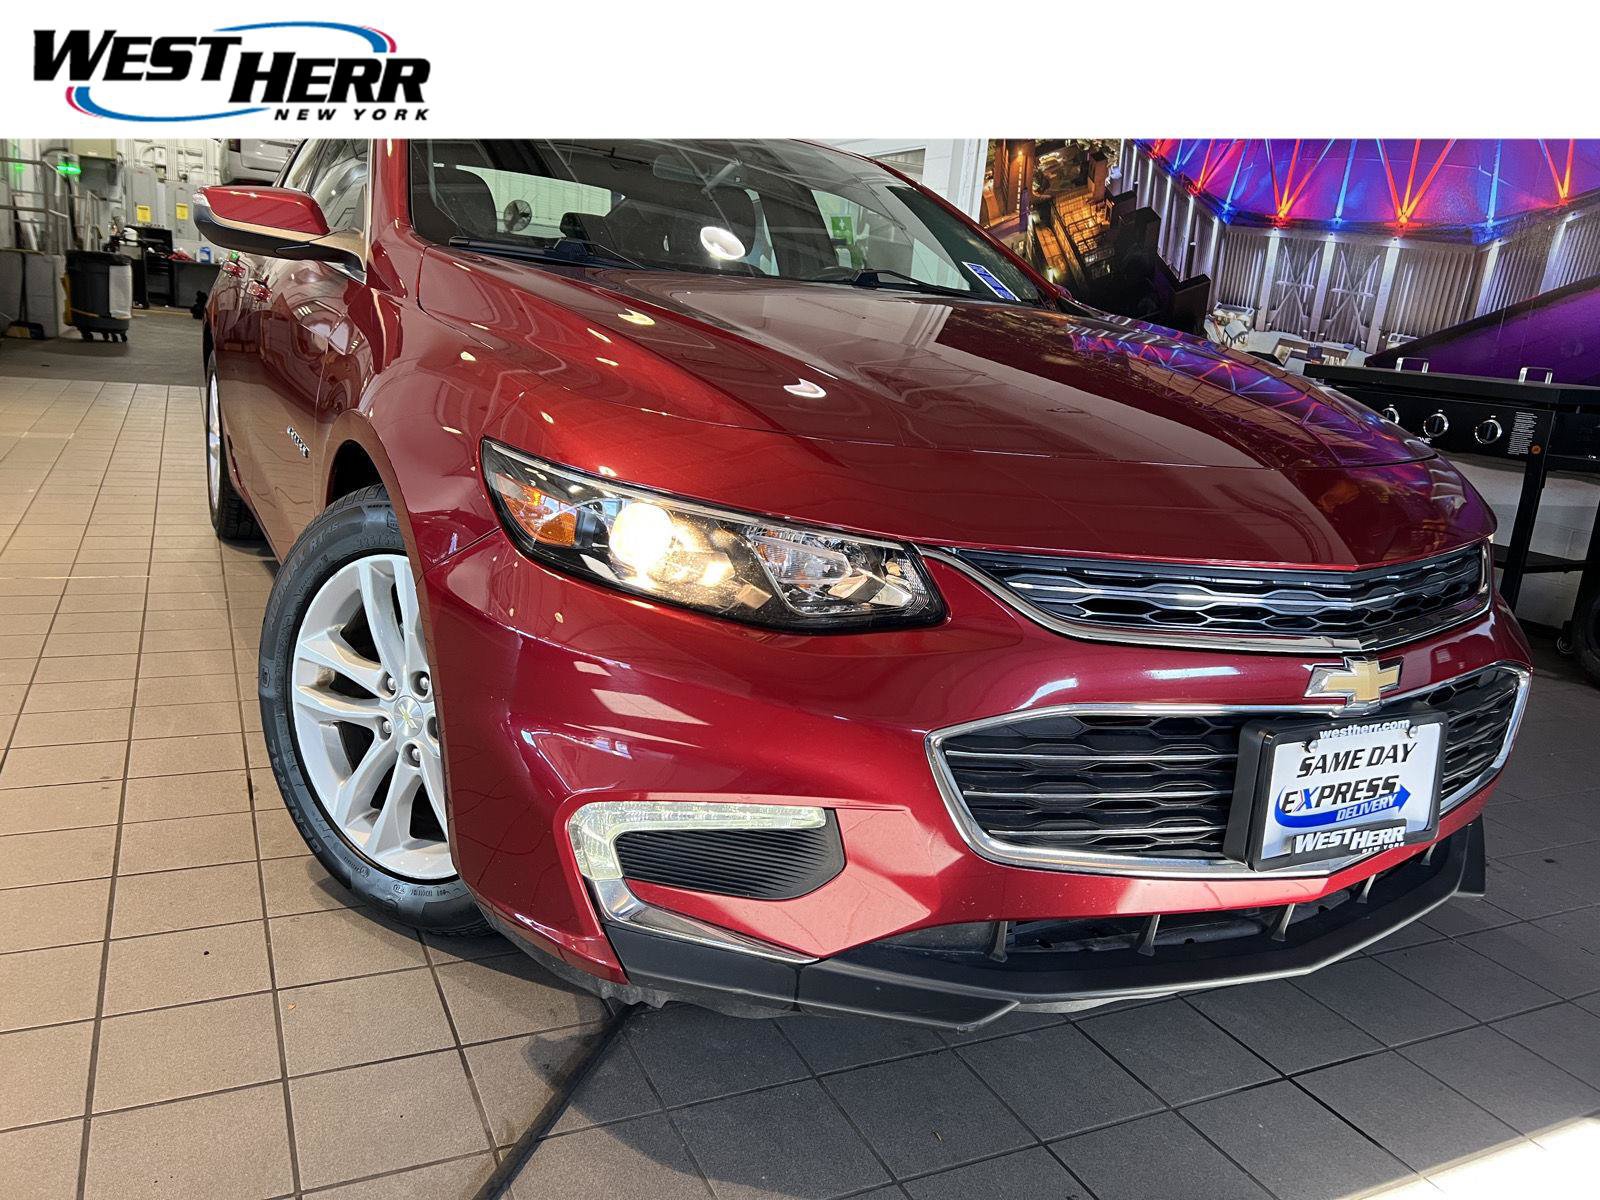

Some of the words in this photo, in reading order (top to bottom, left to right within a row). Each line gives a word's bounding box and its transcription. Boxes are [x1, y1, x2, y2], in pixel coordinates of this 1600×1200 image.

[1319, 719, 1411, 739] westherr.com
[1296, 749, 1365, 778] SAME
[1366, 742, 1418, 767] DAY
[1281, 775, 1400, 814] EXPRESS
[1335, 794, 1398, 821] DELIVERY
[1294, 827, 1357, 854] WEST
[1349, 825, 1407, 851] HERR
